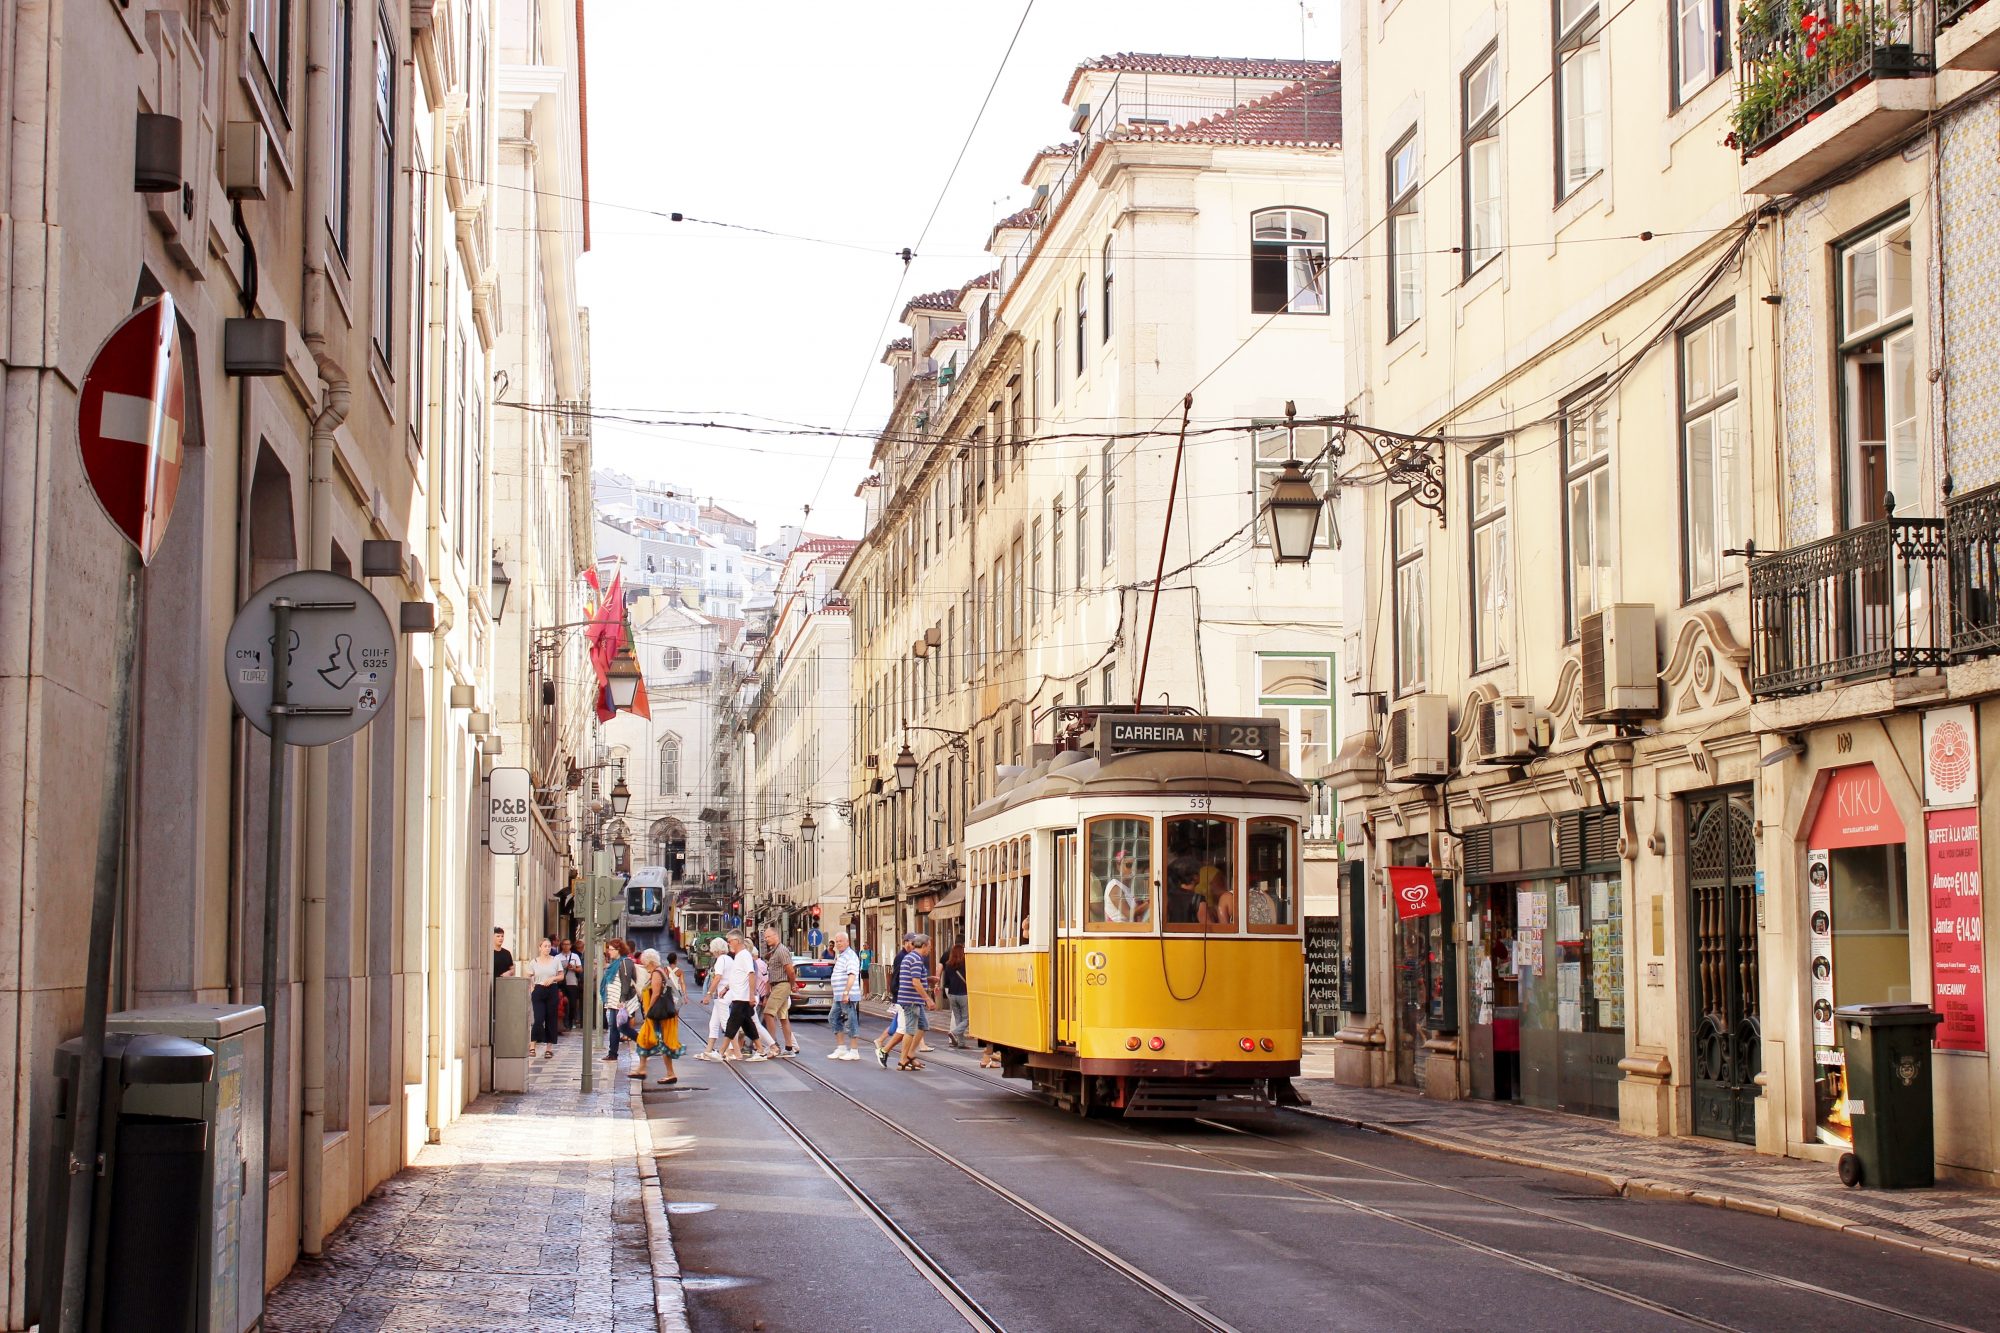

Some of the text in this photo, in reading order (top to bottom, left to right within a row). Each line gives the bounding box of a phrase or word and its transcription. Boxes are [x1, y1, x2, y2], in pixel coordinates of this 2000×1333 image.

[361, 648, 390, 657] CIII-F
[363, 660, 388, 668] 6325
[1115, 725, 1185, 742] CARREIRA
[1230, 727, 1260, 746] 28
[491, 798, 527, 815] P&B
[1190, 798, 1212, 810] 559
[1837, 778, 1882, 818] KIKU
[1929, 828, 1949, 844] BUFFET
[1954, 827, 1960, 842] LA
[1961, 825, 1979, 841] CARTE
[1933, 871, 1979, 897] Almoço €10.90
[1410, 900, 1427, 910] OLÁ
[1934, 916, 1981, 941] Jantar €14.90
[1937, 983, 1967, 996] TAKEAWAY
